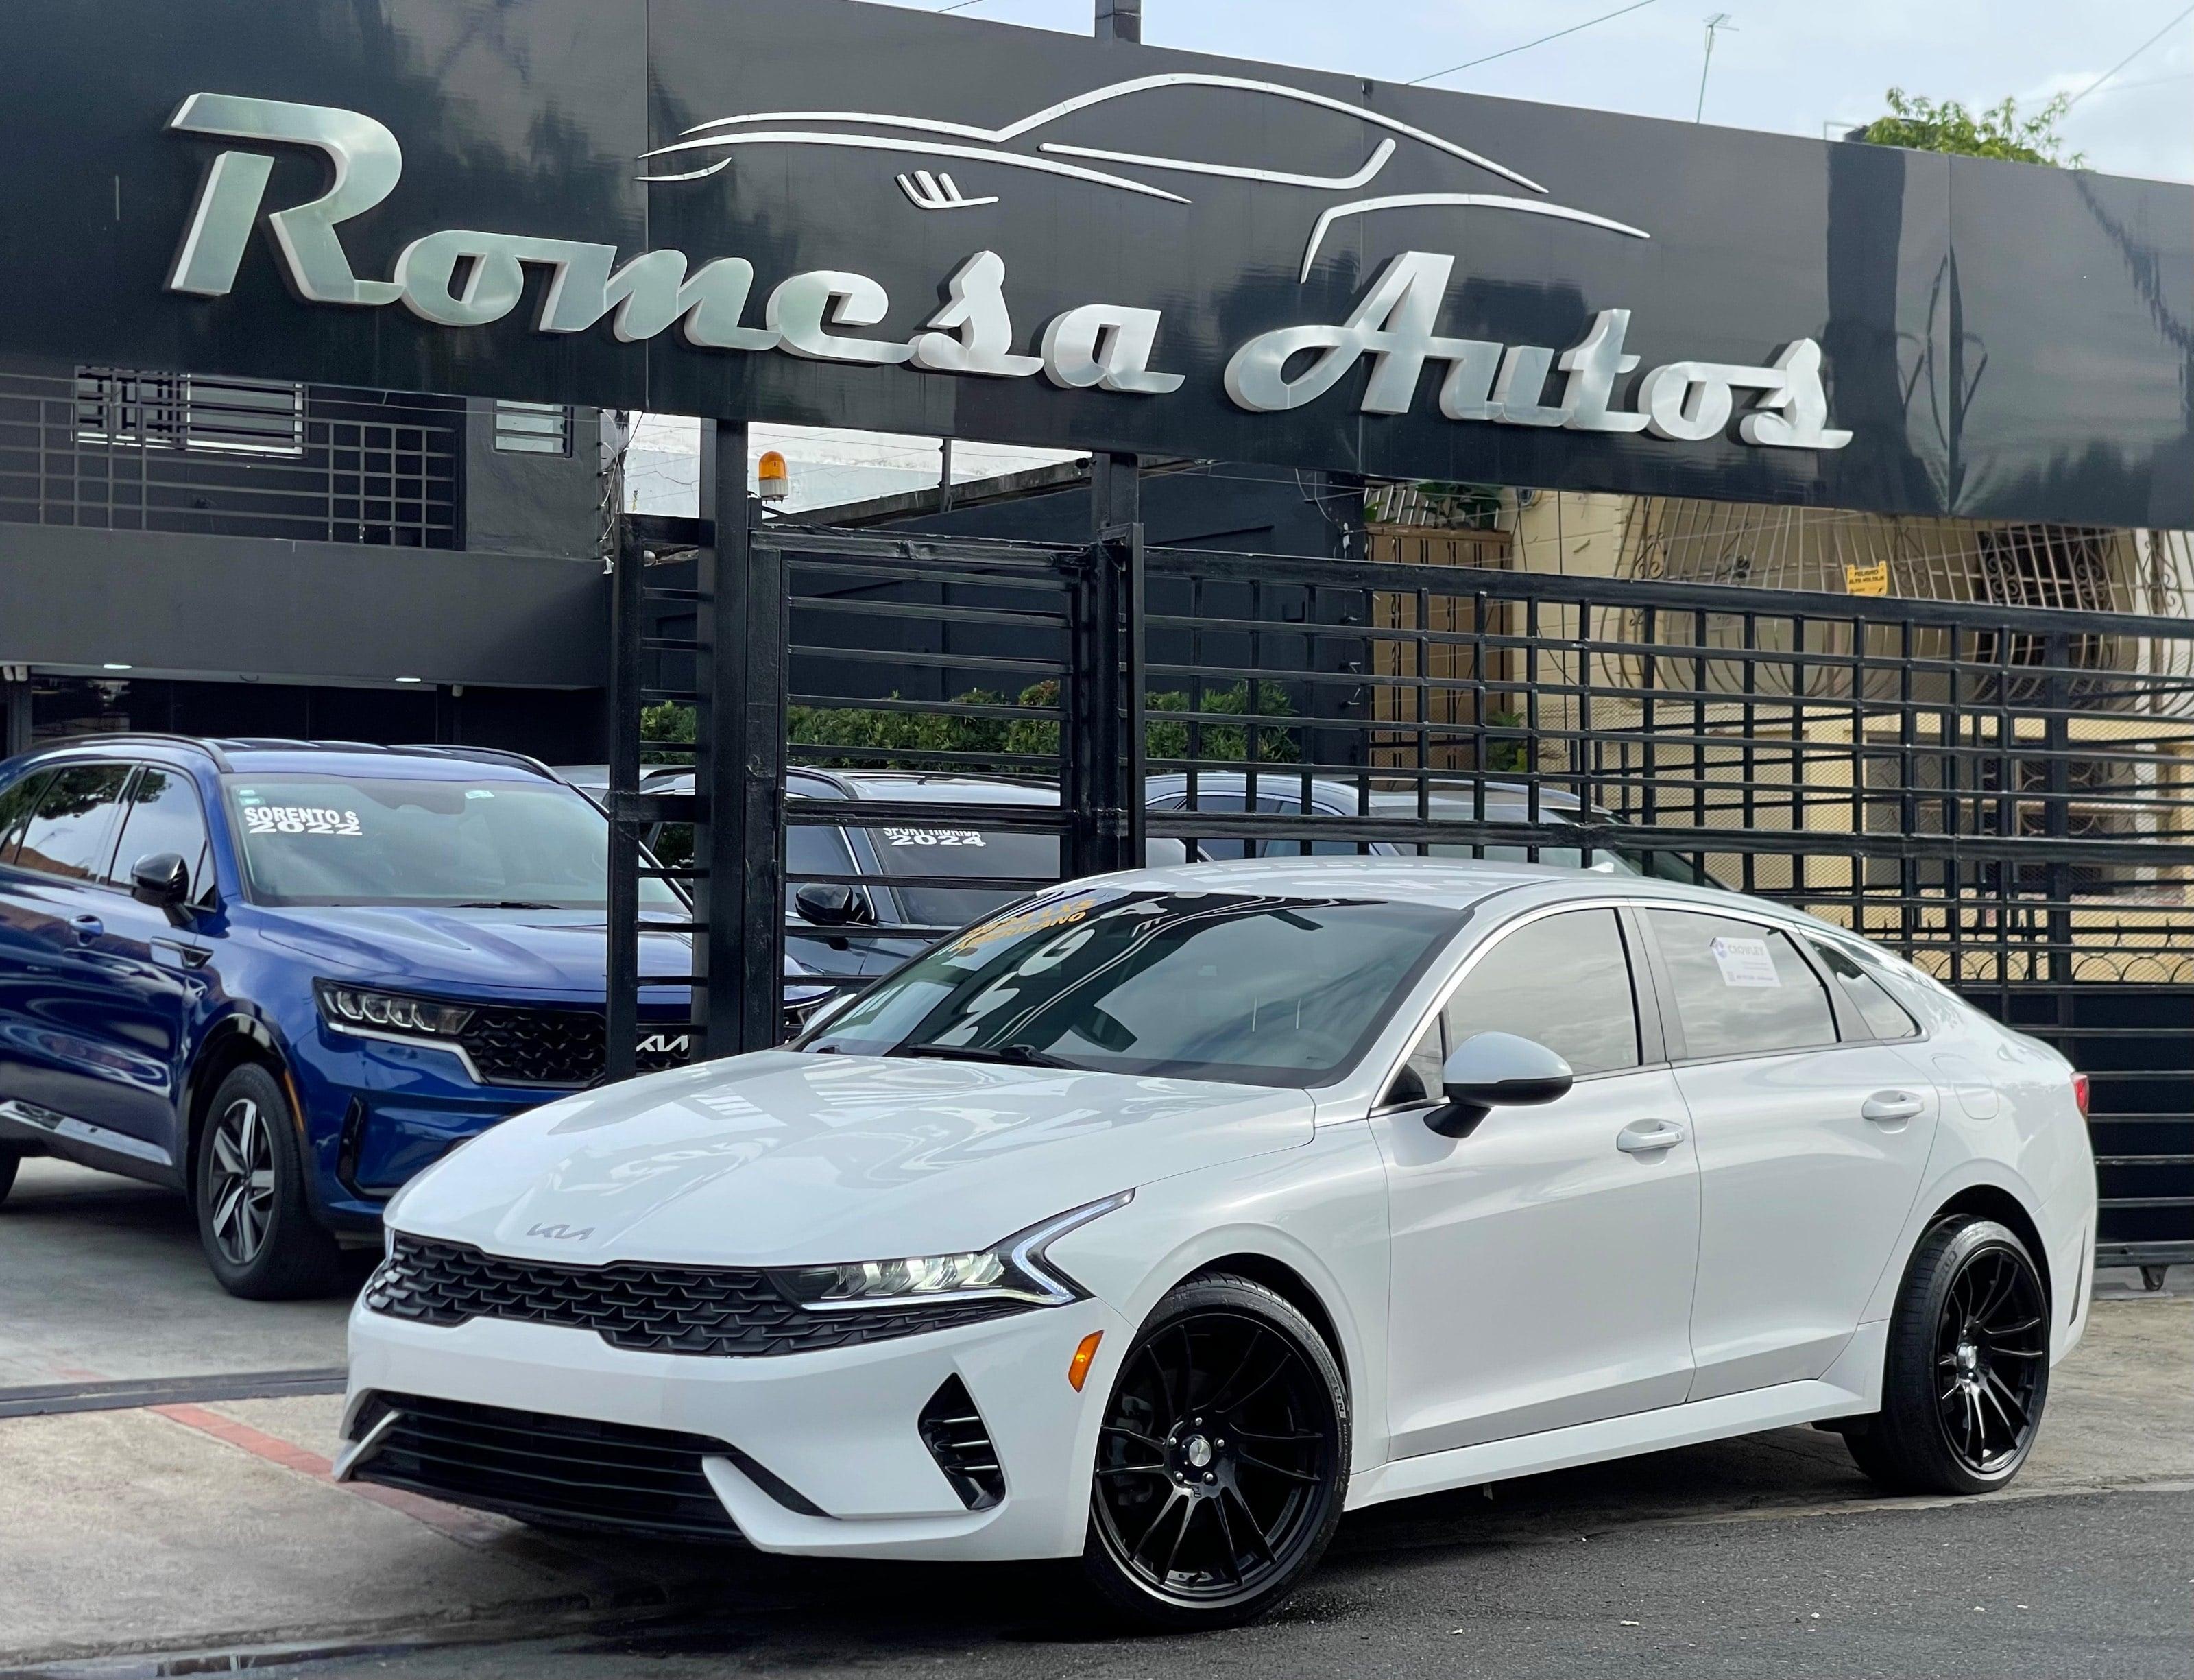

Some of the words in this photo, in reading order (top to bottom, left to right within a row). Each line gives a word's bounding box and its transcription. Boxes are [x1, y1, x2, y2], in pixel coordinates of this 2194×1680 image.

[170, 92, 1185, 394] Romesa
[1224, 250, 1853, 450] Autos
[243, 807, 341, 825] SORENTO
[344, 811, 360, 826] S
[248, 821, 363, 836] 2022
[889, 835, 987, 847] 2024
[636, 1034, 688, 1052] KIA
[525, 1222, 596, 1241] KIA
